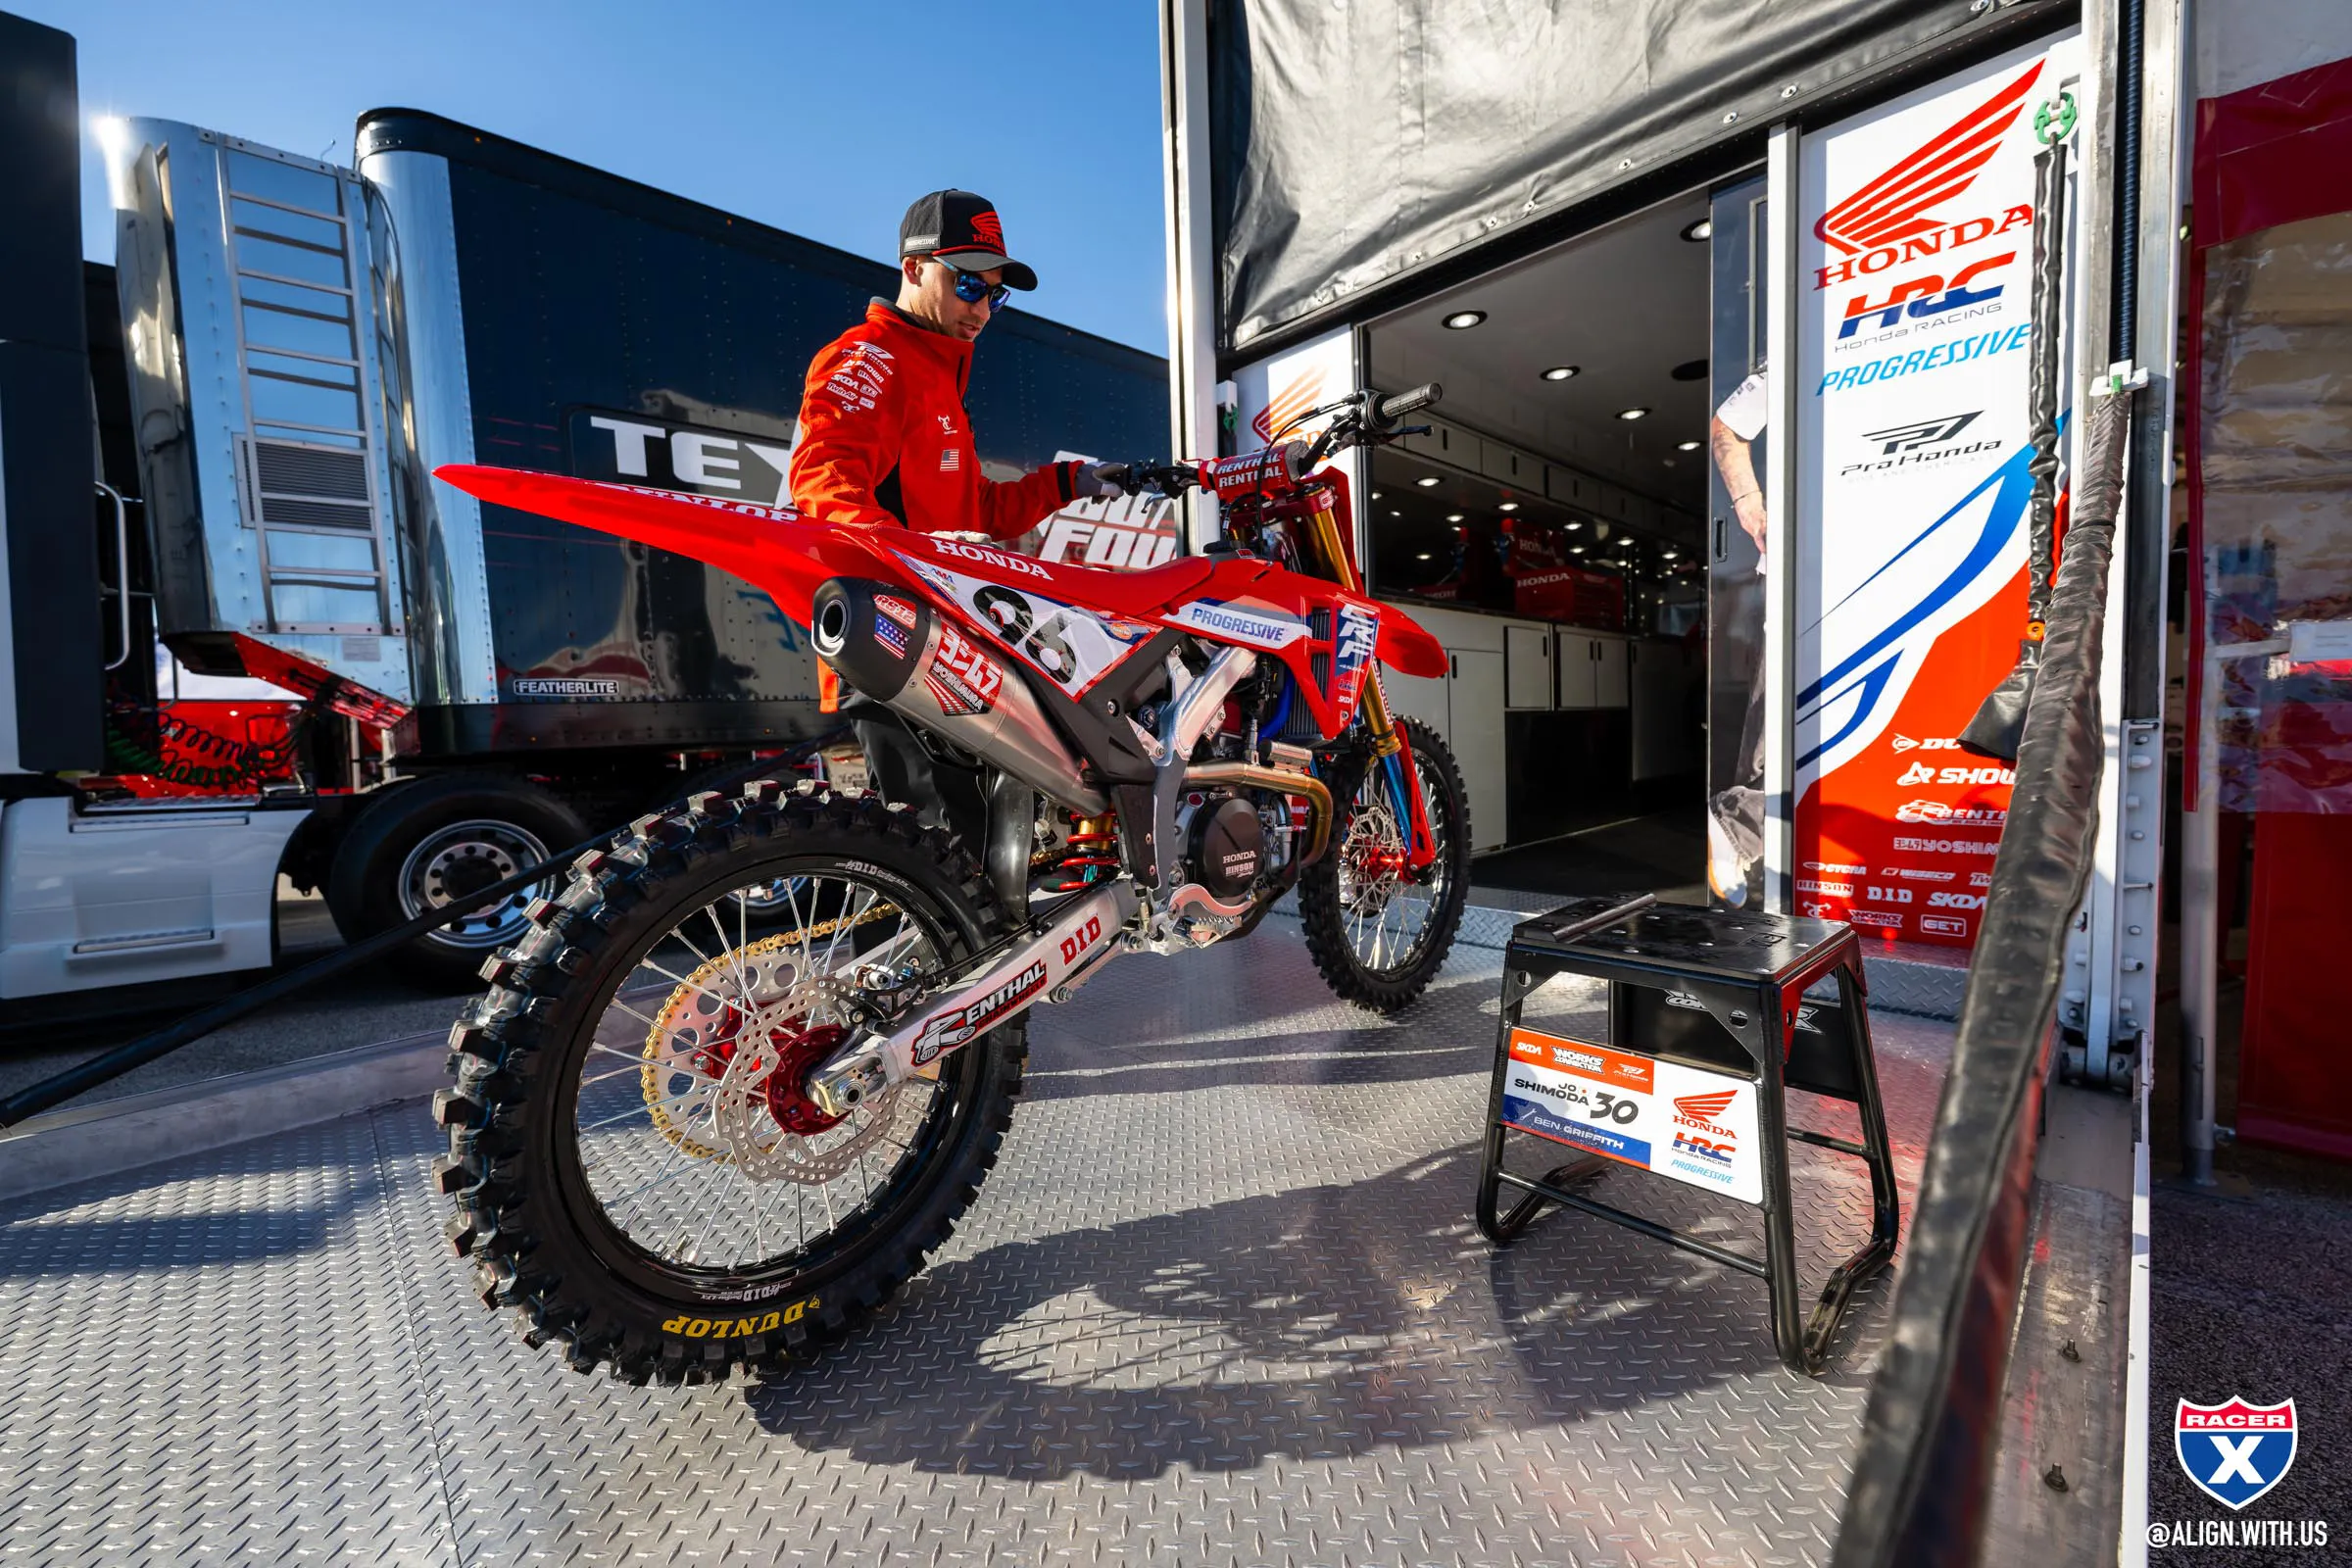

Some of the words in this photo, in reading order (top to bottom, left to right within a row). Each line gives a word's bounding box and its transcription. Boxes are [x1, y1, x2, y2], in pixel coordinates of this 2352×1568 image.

[1813, 204, 2034, 291] HONDA
[1838, 251, 2017, 340] HRC
[1835, 329, 1908, 353] Honda
[1914, 303, 2002, 331] RACING
[1815, 322, 2033, 397] PROGRESSIVE
[1840, 460, 1891, 476] Pro
[1898, 440, 2002, 466] Honda
[930, 538, 1054, 581] HONDA
[1516, 572, 1571, 588] HONDA
[1191, 608, 1285, 642] PROGRESSIVE
[938, 627, 1003, 696] ヨシムラ
[518, 681, 615, 693] FEATHERLITE
[932, 661, 984, 712] YOSHIMURA
[1222, 851, 1256, 864] HONDA
[1225, 861, 1254, 876] HINSON
[1798, 881, 1853, 894] HINSON
[1867, 886, 1912, 903] D.I.D
[1059, 915, 1102, 966] D.I.D
[1923, 919, 1963, 931] GET
[1515, 1042, 1543, 1055] SKDA
[1551, 1046, 1605, 1067] WORKS
[1514, 1078, 1590, 1106] SHIMODA
[1558, 1082, 1577, 1093] JO
[1590, 1092, 1640, 1125] 30
[1534, 1116, 1561, 1130] BEN
[1563, 1125, 1625, 1150] GRIFFITH
[1672, 1115, 1739, 1140] HONDA
[1672, 1131, 1737, 1163] HRC
[1671, 1158, 1735, 1184] PROGRESSIVE
[662, 1300, 807, 1339] DUNLOP
